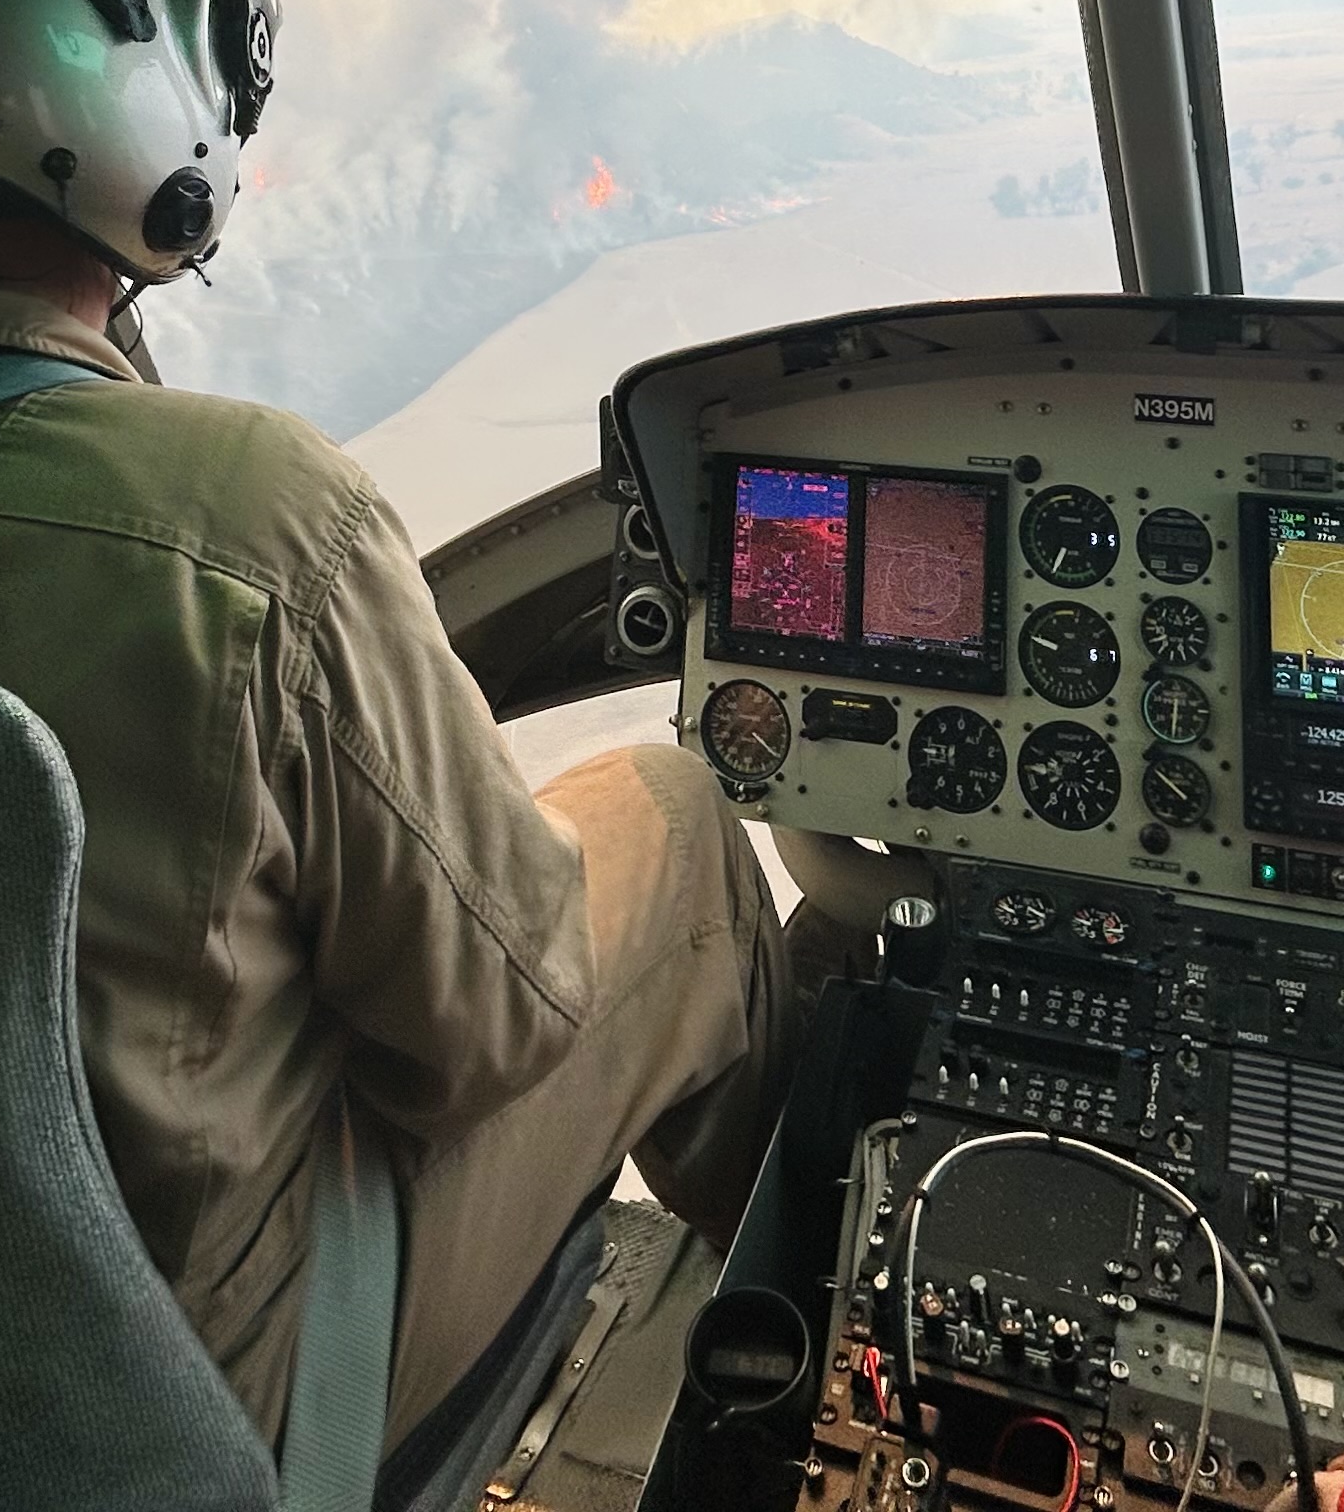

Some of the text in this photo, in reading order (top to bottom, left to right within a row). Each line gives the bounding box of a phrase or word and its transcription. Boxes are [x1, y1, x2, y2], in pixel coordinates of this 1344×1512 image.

[1135, 397, 1214, 422] N395M
[1186, 962, 1208, 972] CHIP
[1187, 970, 1205, 980] DET
[1276, 978, 1307, 991] FORCE
[1279, 987, 1305, 999] TRIM
[1145, 1062, 1161, 1120] CAUTION
[1132, 1192, 1146, 1249] ENGINE
[1155, 1226, 1183, 1240] EMER
[1148, 1286, 1180, 1301] CONT
